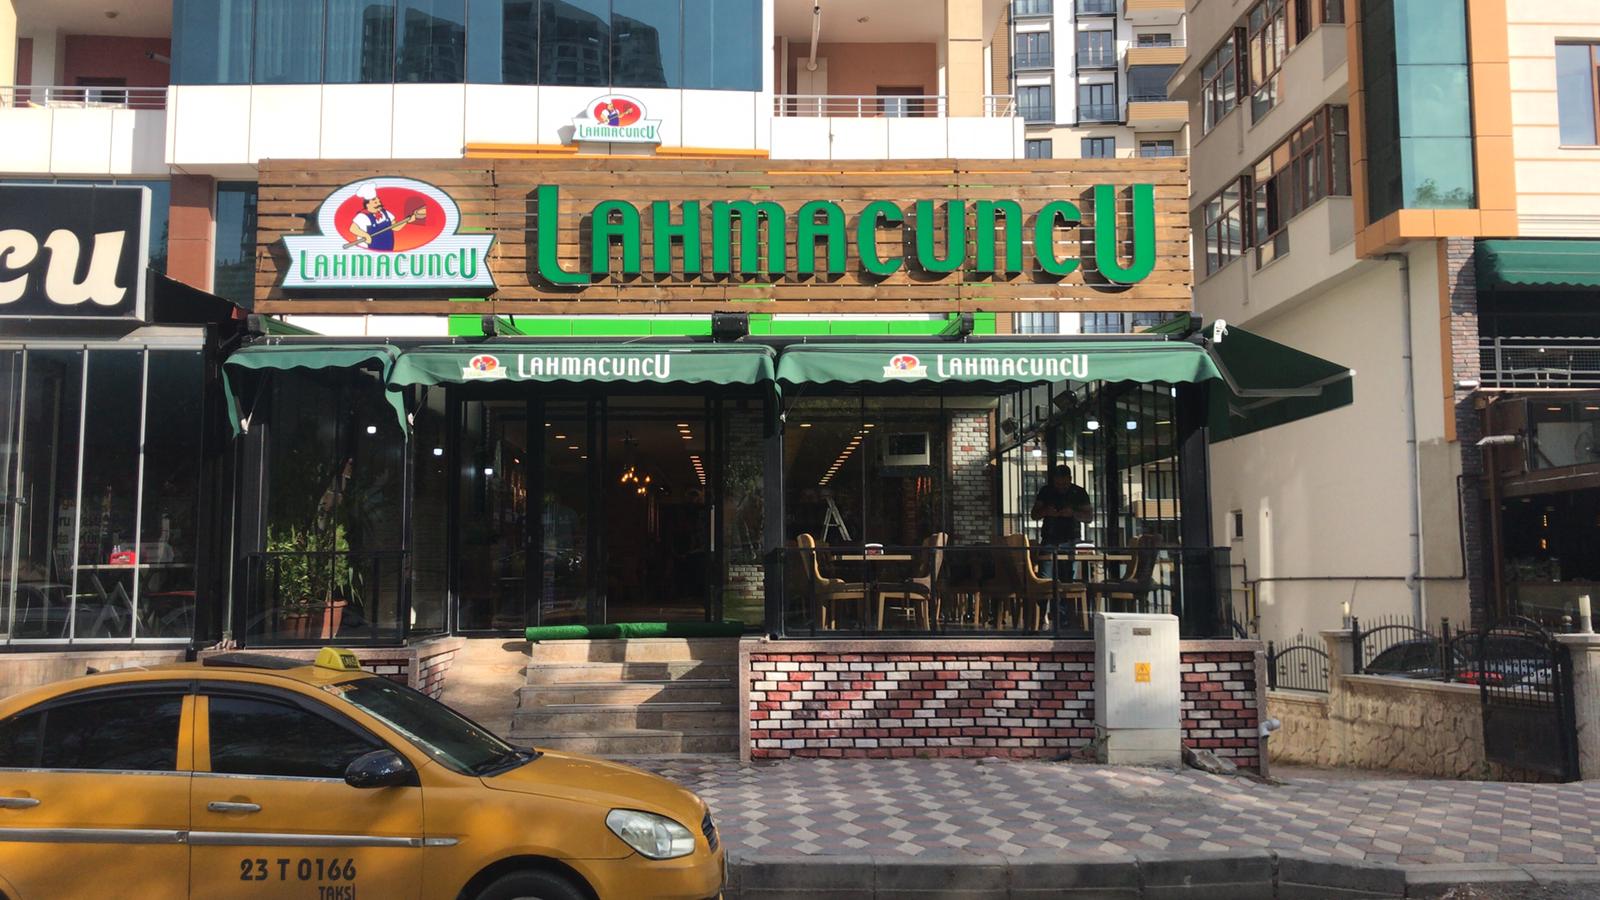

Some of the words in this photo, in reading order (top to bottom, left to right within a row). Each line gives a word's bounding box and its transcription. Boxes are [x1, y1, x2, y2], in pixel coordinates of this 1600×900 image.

[579, 124, 655, 140] LAHMACUNCU
[536, 184, 1156, 286] LAHMACUNCU
[299, 247, 478, 282] LAHMACUNCU
[517, 353, 671, 379] LAHMACUNCU
[936, 353, 1089, 379] LAHMACUNCU
[240, 858, 269, 881] 23
[277, 858, 290, 881] T
[297, 857, 357, 881] 0166
